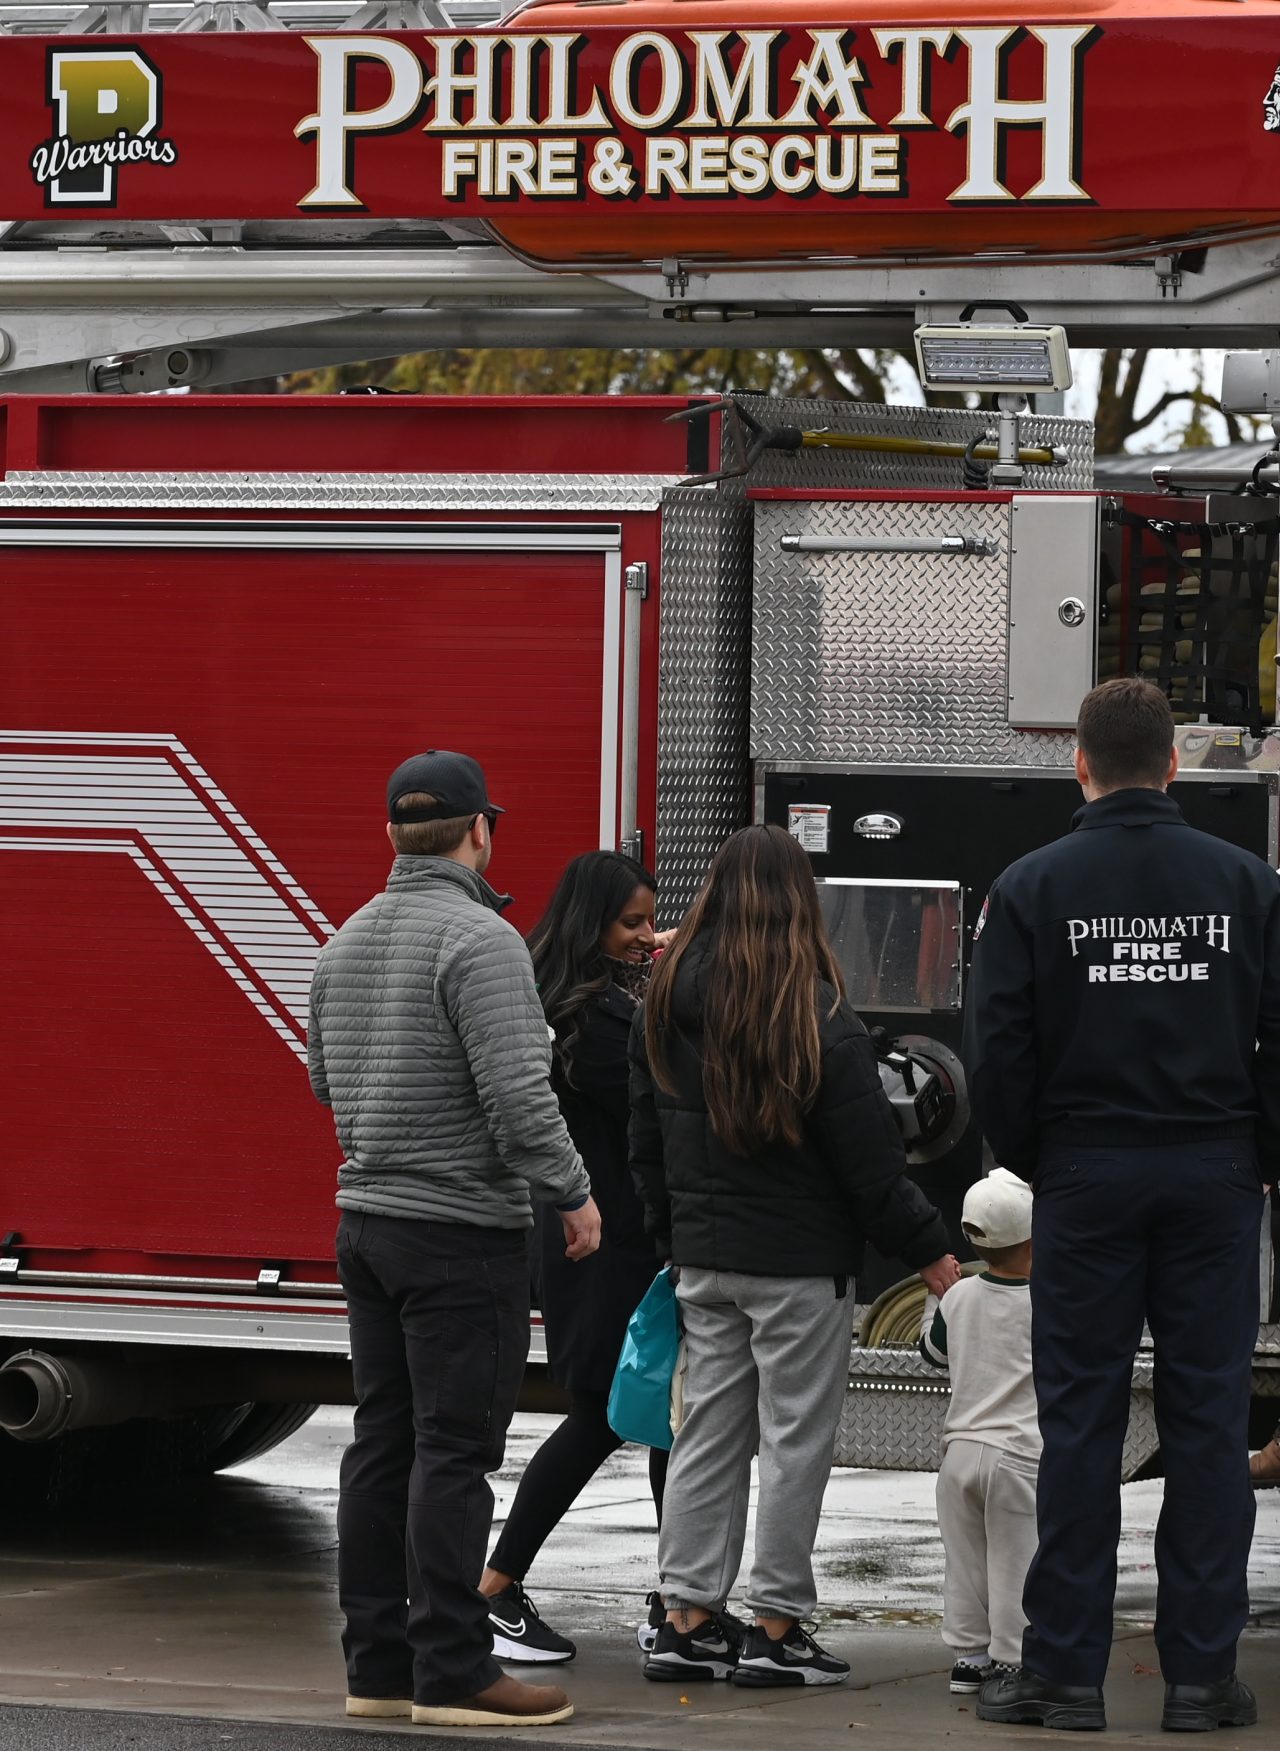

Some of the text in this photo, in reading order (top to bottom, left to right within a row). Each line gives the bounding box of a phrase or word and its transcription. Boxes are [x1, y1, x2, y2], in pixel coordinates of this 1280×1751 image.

[48, 48, 160, 205] P
[293, 23, 1098, 206] PHILOMATH
[31, 131, 176, 183] Warriors
[441, 132, 901, 197] FIRE & RESCUE
[1066, 914, 1232, 957] PHILOMATH
[1113, 942, 1182, 960] FIRE
[1088, 963, 1209, 983] RESCUE
